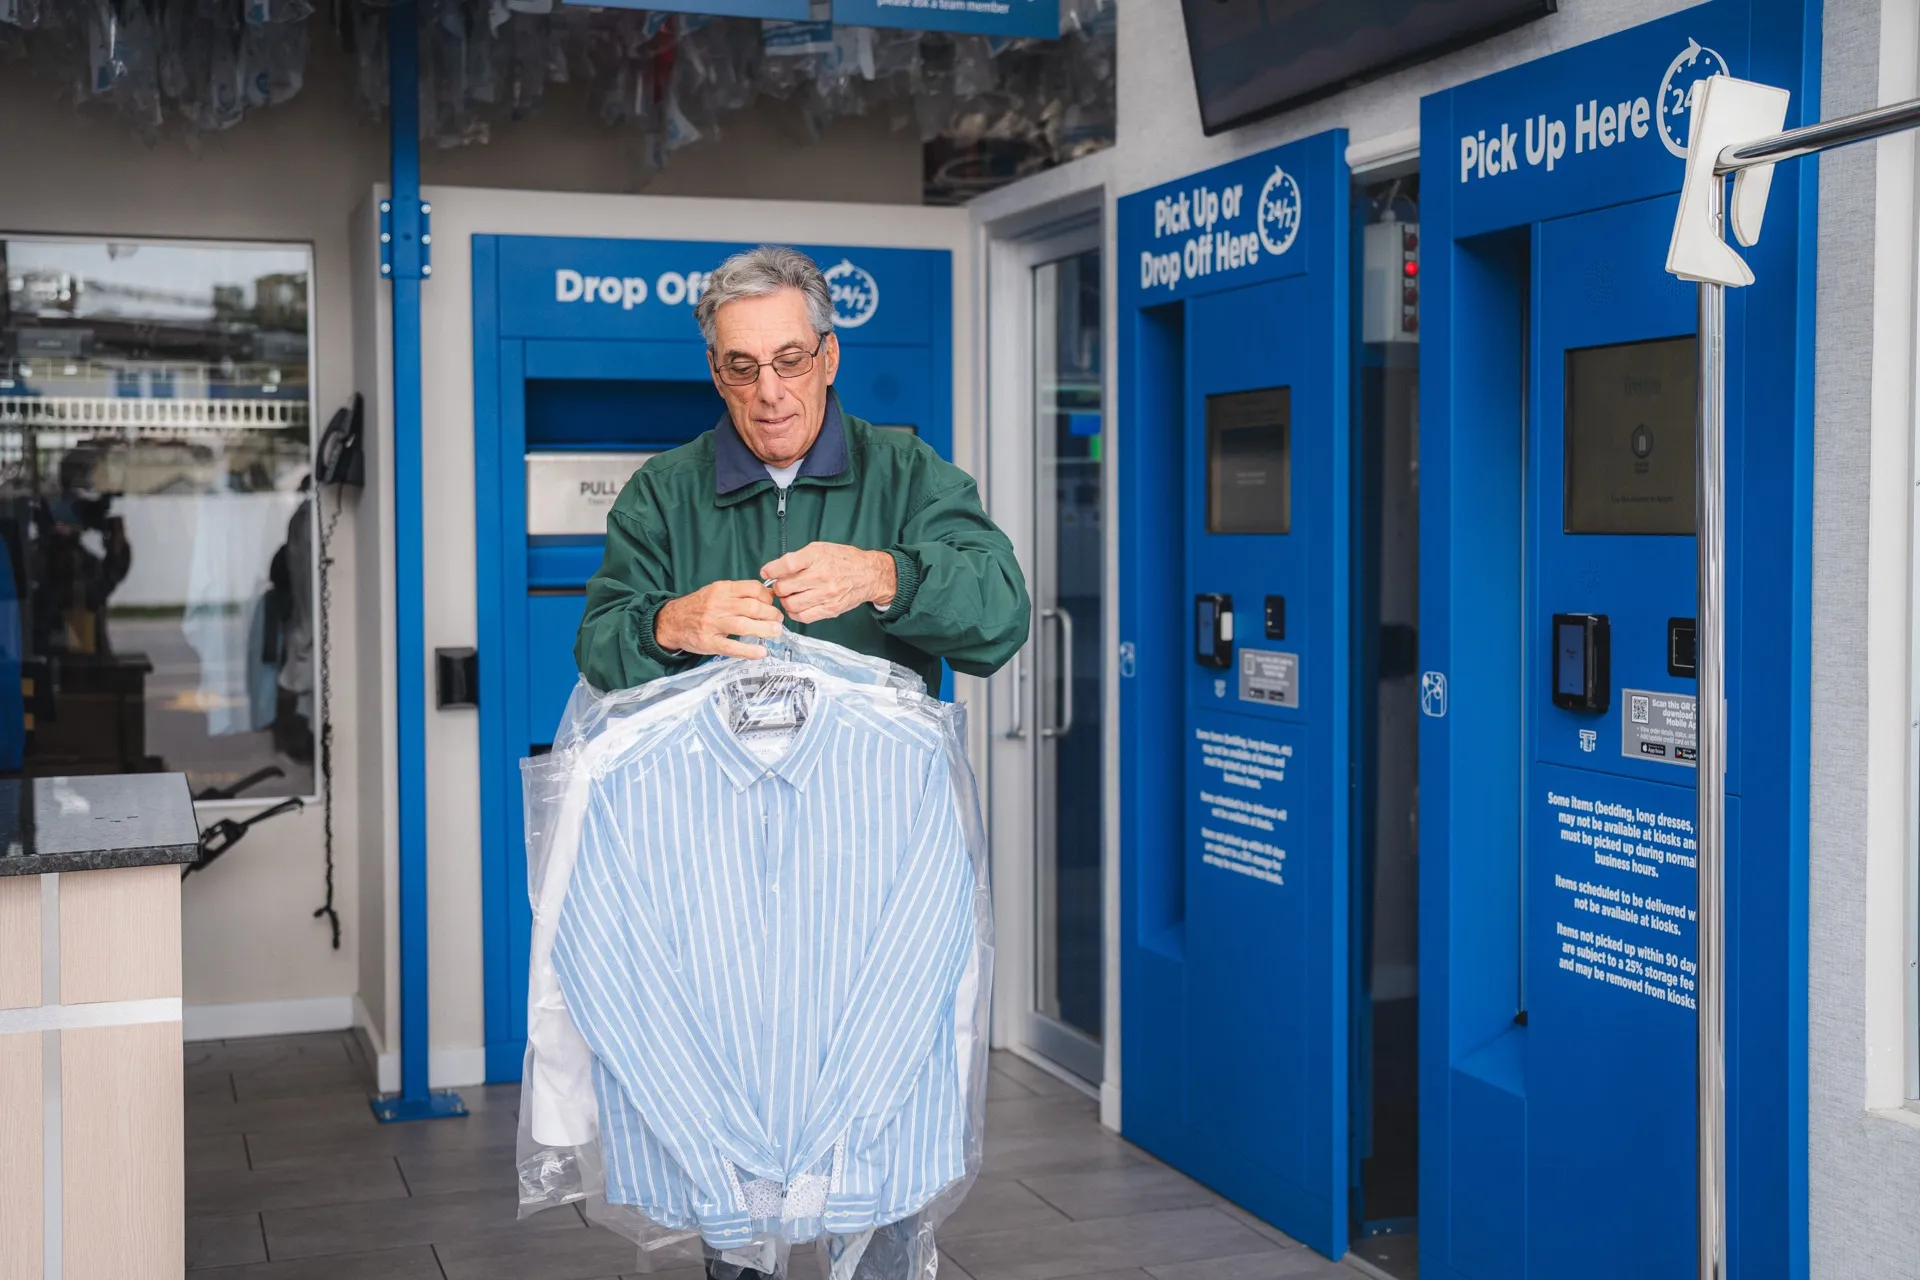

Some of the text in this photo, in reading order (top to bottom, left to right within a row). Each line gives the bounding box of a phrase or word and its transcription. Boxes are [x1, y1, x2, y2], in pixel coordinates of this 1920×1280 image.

[966, 1, 1010, 14] member
[1672, 86, 1694, 116] 24
[1461, 97, 1650, 183] Pick Up Here
[1155, 184, 1243, 238] Pick Up or
[1267, 198, 1293, 229] 24/7
[1141, 230, 1259, 291] Drop Off Here
[556, 269, 648, 310] Drop
[580, 482, 617, 496] PULL
[1652, 699, 1667, 708] Scan
[1668, 701, 1680, 709] this
[1680, 702, 1691, 711] QR
[1662, 709, 1694, 720] download
[1666, 718, 1687, 727] Mobile
[1548, 791, 1694, 835] Some items (bedding, long dresses,
[1558, 812, 1575, 828] may
[1576, 815, 1591, 829] not
[1592, 817, 1602, 830] be
[1604, 820, 1641, 839] available
[1642, 828, 1652, 842] at
[1653, 829, 1681, 848] kiosks
[1560, 829, 1697, 869] must be picked up during normal
[1594, 851, 1659, 878] business hours.
[1555, 874, 1577, 891] Items
[1578, 881, 1620, 902] scheduled
[1621, 891, 1631, 905] to
[1632, 893, 1643, 908] be
[1645, 897, 1686, 919] delivered
[1574, 897, 1588, 910] not
[1589, 899, 1600, 914] be
[1601, 904, 1639, 924] available
[1640, 914, 1649, 927] at
[1651, 915, 1681, 936] kiosks.
[1556, 921, 1697, 976] Items not picked up within 90 day
[1562, 942, 1695, 991] are subject to a 25% storage fee
[1559, 957, 1574, 972] and
[1575, 963, 1593, 979] may
[1594, 966, 1605, 981] be
[1606, 972, 1643, 993] removed
[1644, 982, 1666, 1000] from
